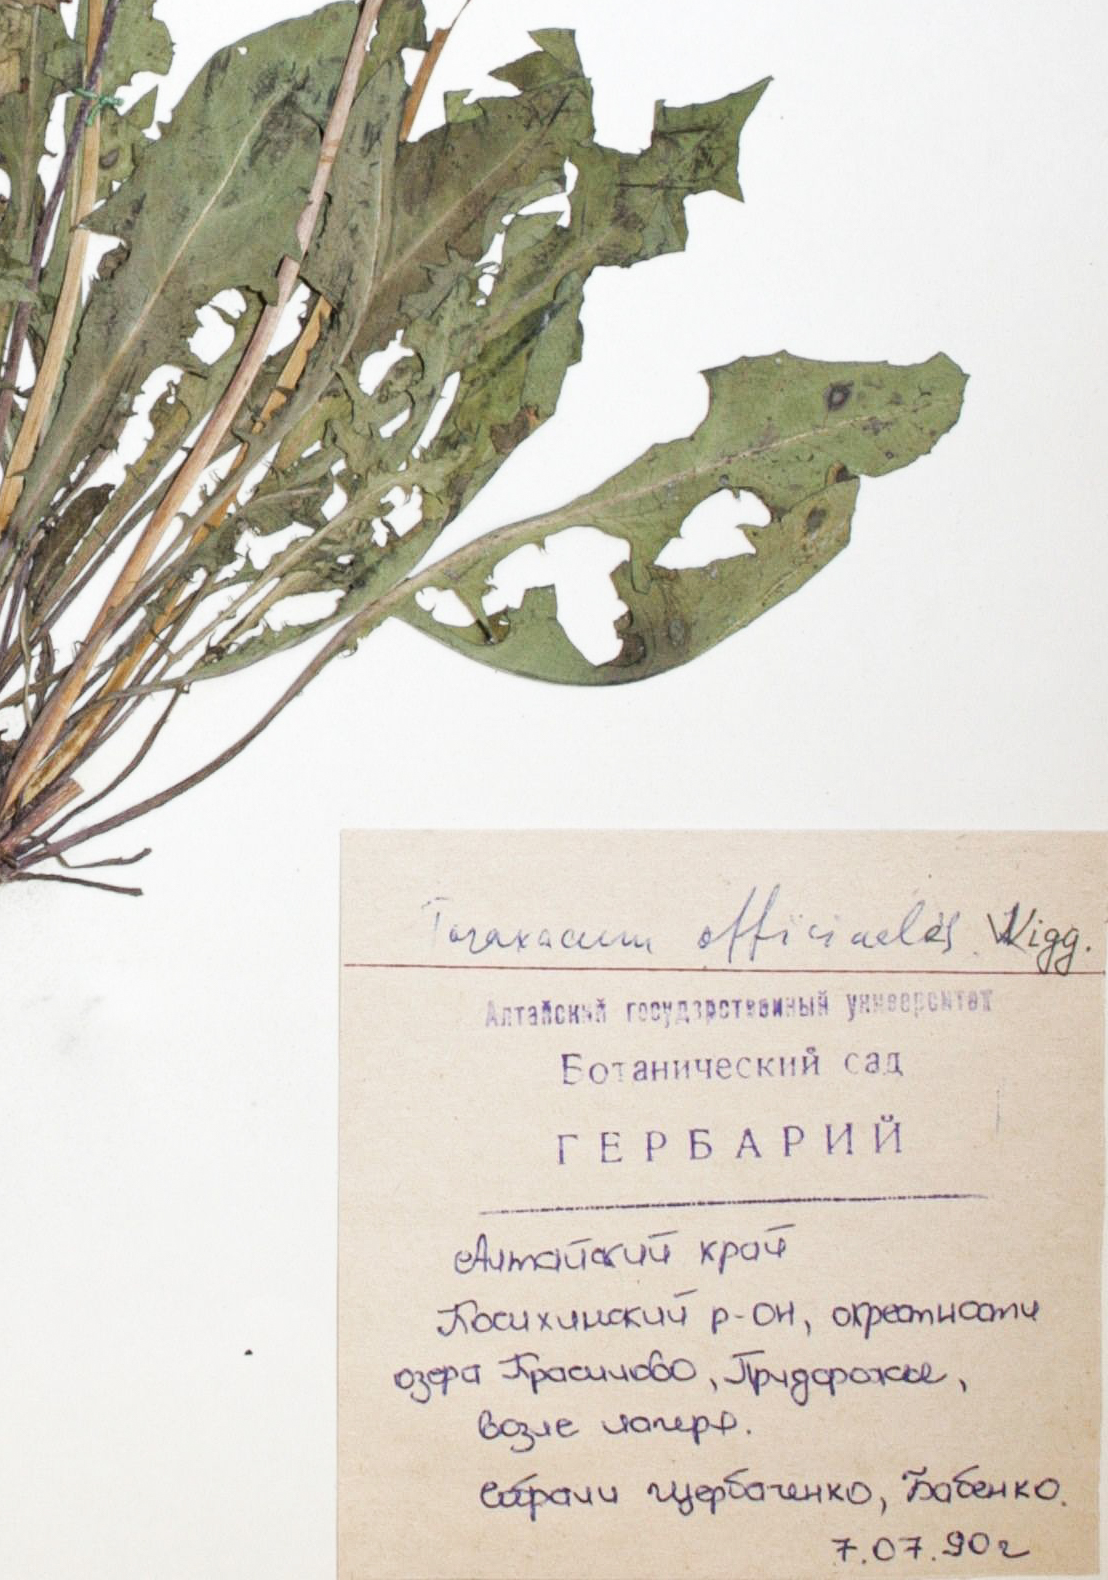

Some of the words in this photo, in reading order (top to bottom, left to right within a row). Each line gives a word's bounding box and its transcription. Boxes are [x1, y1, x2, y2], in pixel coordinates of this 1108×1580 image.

[561, 1046, 821, 1086] Ботанический
[844, 1049, 904, 1076] сад
[556, 1114, 904, 1165] ГЕРБАРИЙ
[454, 1230, 678, 1274] Алтайский
[700, 1223, 795, 1274] край
[393, 1364, 481, 1404] озера
